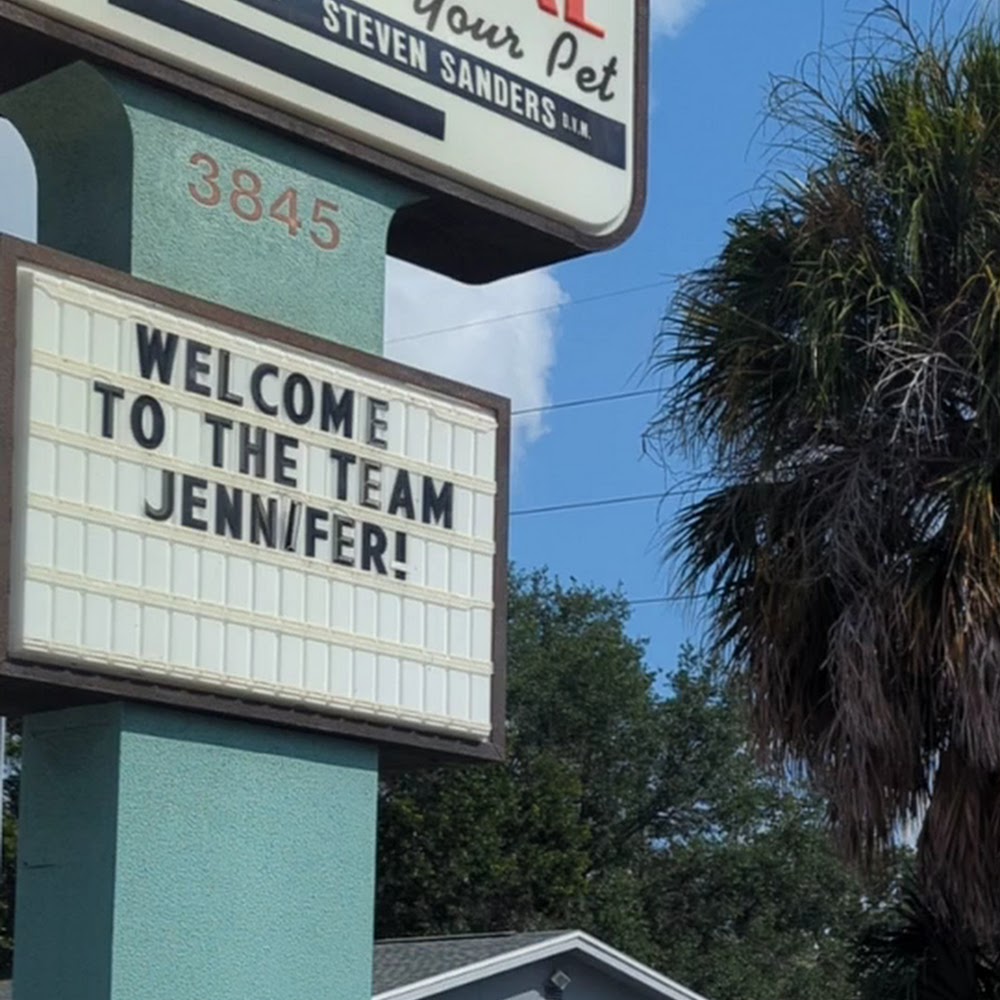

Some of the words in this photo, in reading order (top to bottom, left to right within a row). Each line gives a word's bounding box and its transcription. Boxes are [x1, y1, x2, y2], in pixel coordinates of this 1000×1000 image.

[323, 0, 428, 73] STEVEN
[440, 50, 556, 130] SANDERS
[546, 31, 618, 102] Pet
[187, 152, 342, 252] 3845
[137, 323, 388, 449] WELCOME
[94, 381, 166, 450] TO
[204, 413, 300, 487] THE
[330, 450, 454, 529] TEAM
[144, 469, 408, 581] JENNIFER!
